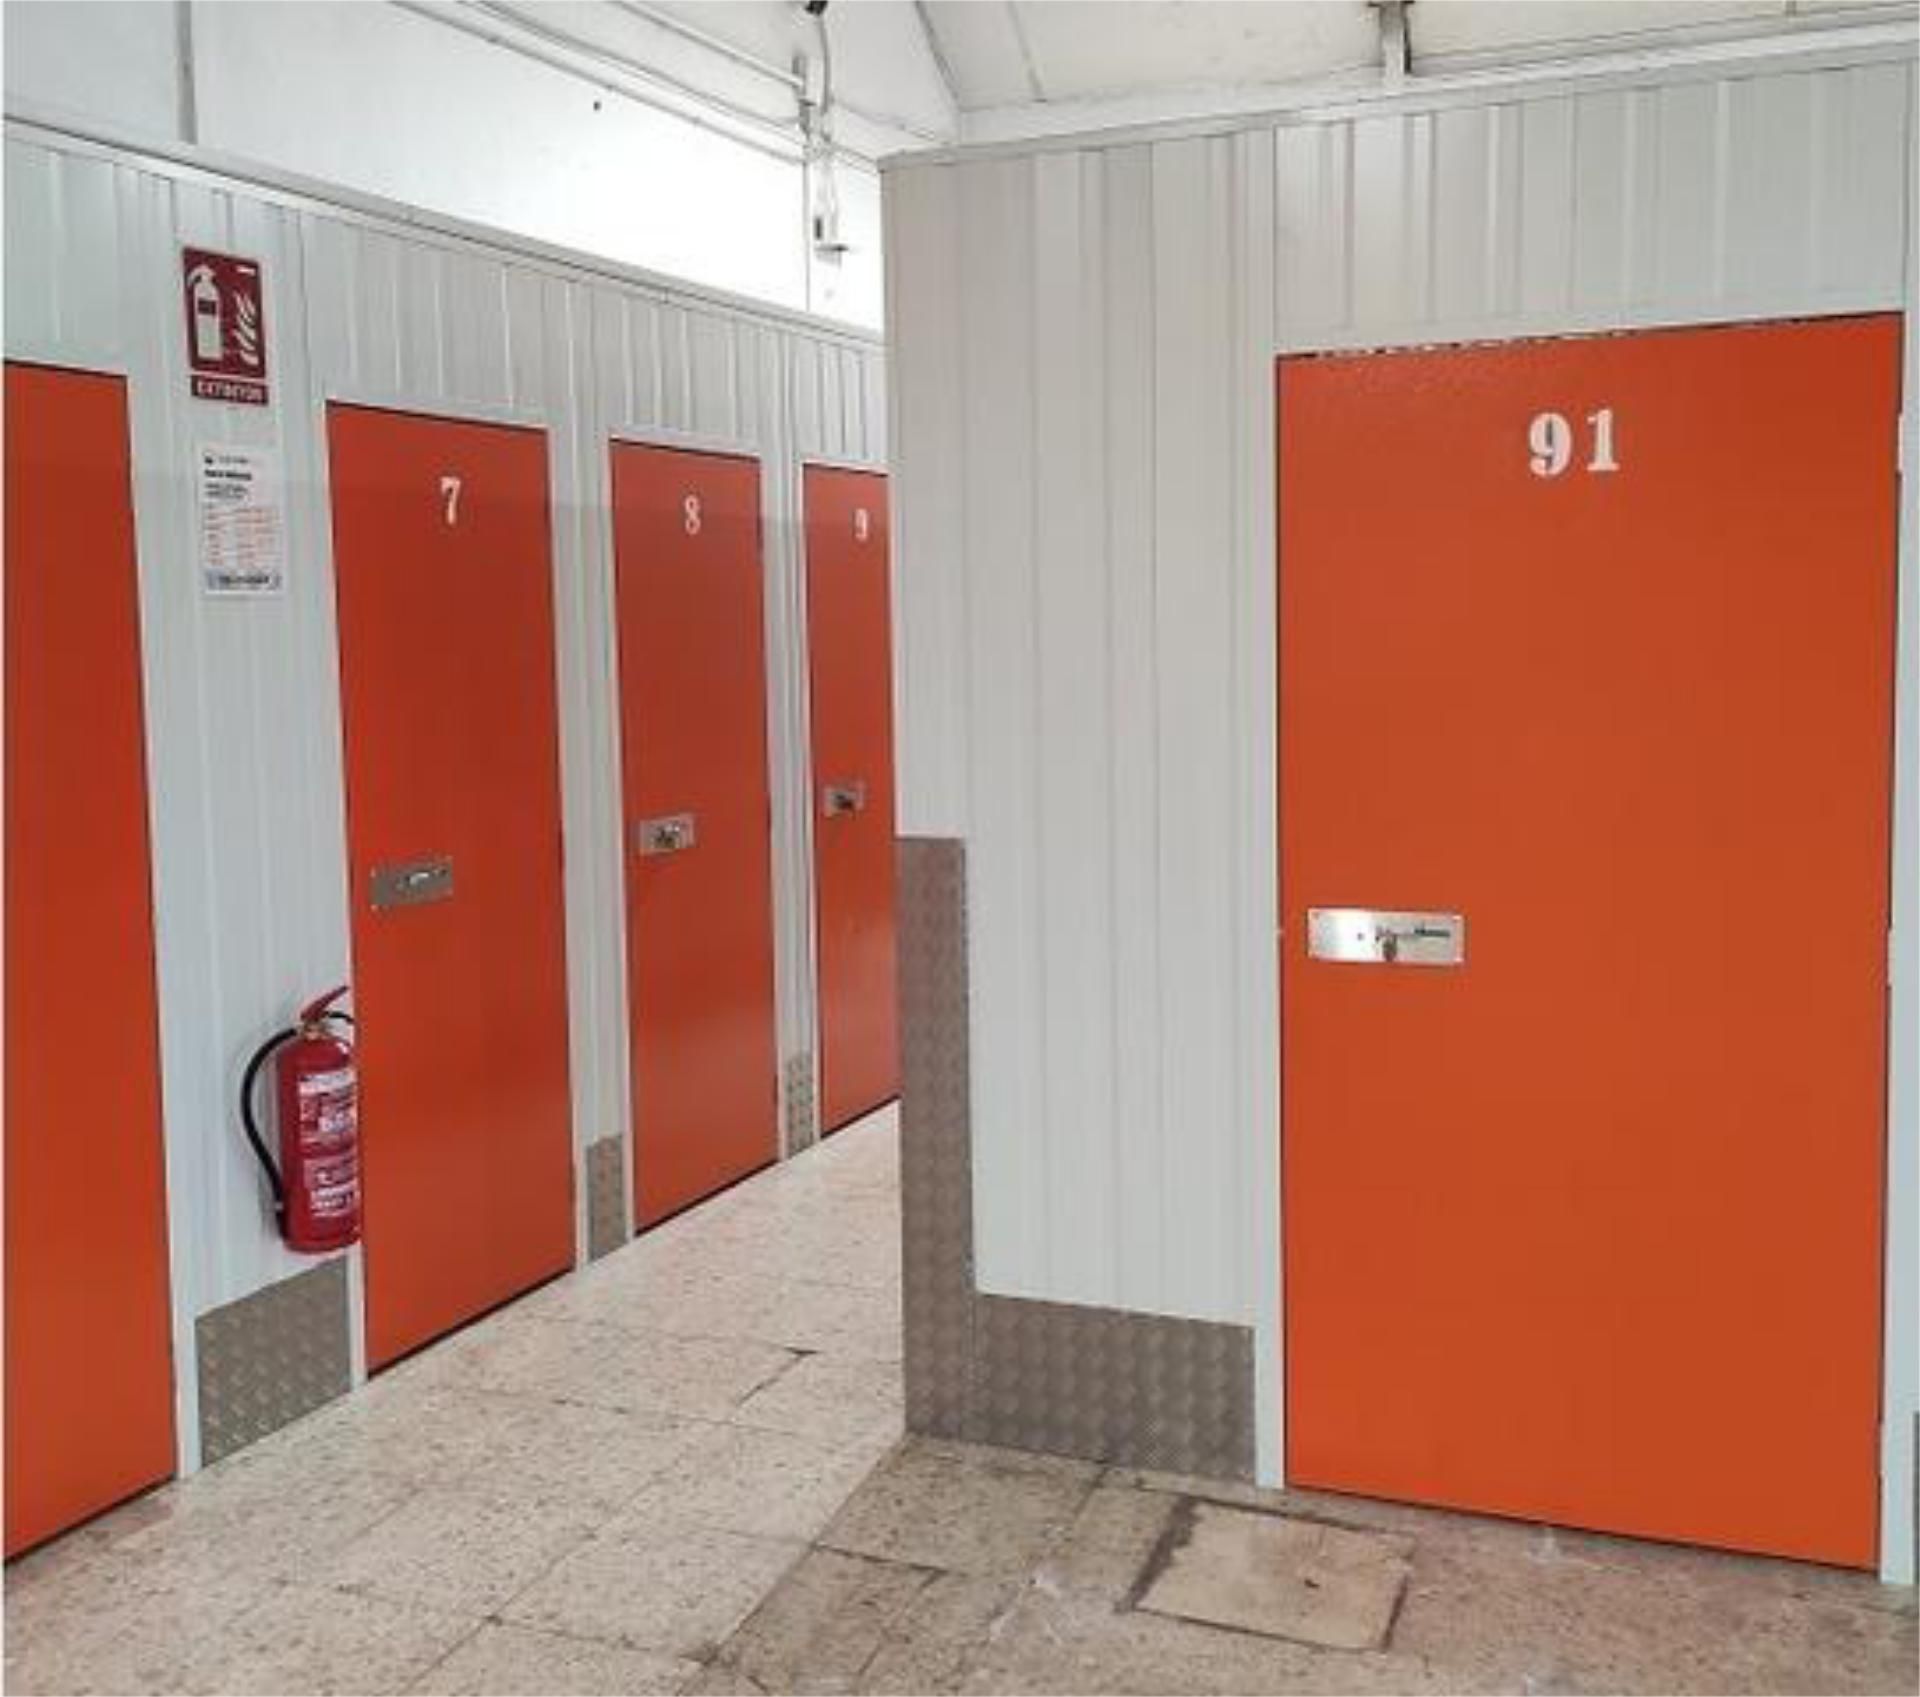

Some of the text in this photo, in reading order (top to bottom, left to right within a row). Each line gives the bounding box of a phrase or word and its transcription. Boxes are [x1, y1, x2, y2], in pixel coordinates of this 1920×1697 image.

[1528, 408, 1621, 475] 91
[440, 476, 461, 525] 7
[684, 495, 701, 535] 8
[855, 508, 869, 542] 9
